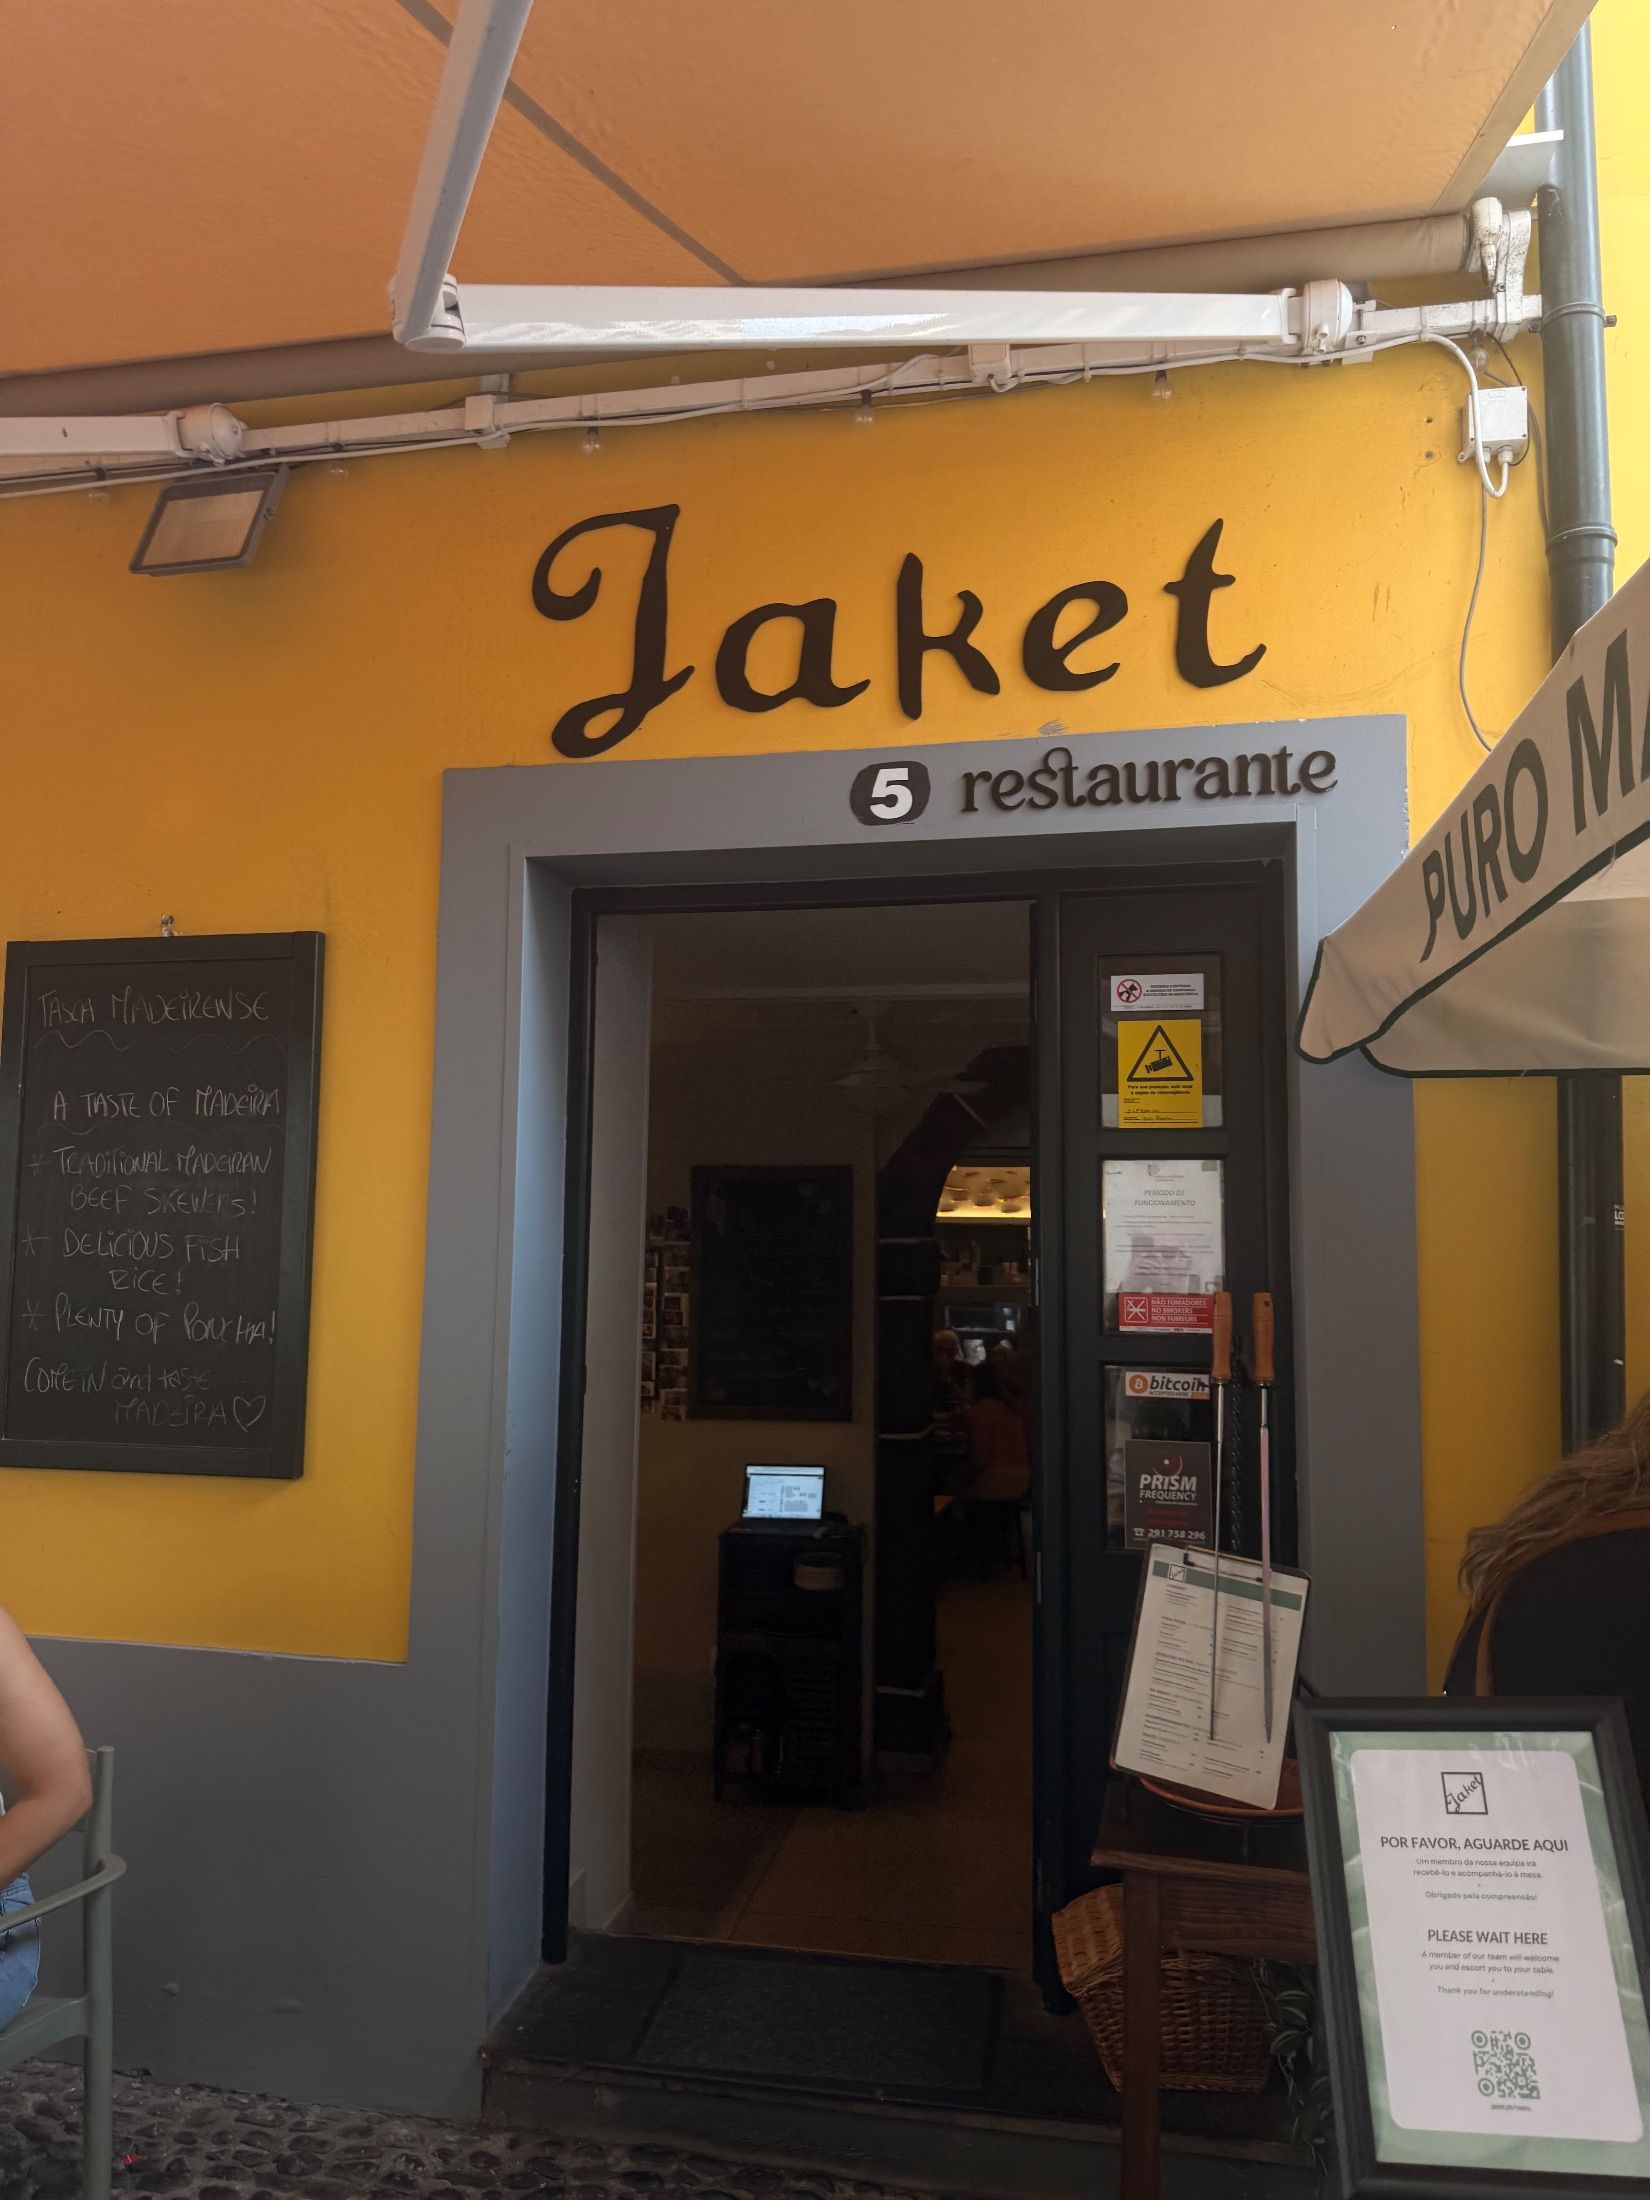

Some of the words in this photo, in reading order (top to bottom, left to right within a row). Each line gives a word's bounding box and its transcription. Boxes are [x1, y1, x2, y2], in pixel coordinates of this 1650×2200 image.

[531, 503, 1267, 758] Jaket
[868, 767, 915, 820] 5
[962, 744, 1339, 813] restaurante
[1420, 738, 1548, 963] PURO
[1566, 628, 1650, 836] M
[54, 1090, 67, 1121] A
[80, 1092, 141, 1119] TASTE
[150, 1087, 180, 1117] OF
[70, 1185, 132, 1214] BEEF
[135, 1311, 171, 1344] OF
[1139, 1474, 1198, 1491] PRISM
[1139, 1490, 1198, 1501] FREQUENCY
[1446, 1774, 1483, 1813] Jaket
[1380, 1836, 1409, 1848] POR
[1412, 1837, 1461, 1851] FAVOR,
[1463, 1838, 1530, 1851] AGUARDE
[1533, 1839, 1569, 1853] AQUI
[1499, 1860, 1525, 1868] equipa
[1425, 1890, 1462, 1901] Obrigado
[1463, 1891, 1480, 1900] pela
[1428, 1929, 1473, 1943] PLEASE
[1476, 1931, 1510, 1944] WAIT
[1513, 1932, 1548, 1945] HERE
[1428, 1951, 1461, 1959] member
[1509, 1953, 1522, 1961] will
[1524, 1954, 1560, 1962] welcome
[1429, 1964, 1444, 1972] you
[1487, 1965, 1502, 1973] you
[1437, 1986, 1461, 1994] Thank
[1463, 1988, 1478, 1996] you
[1479, 1987, 1491, 1995] for
